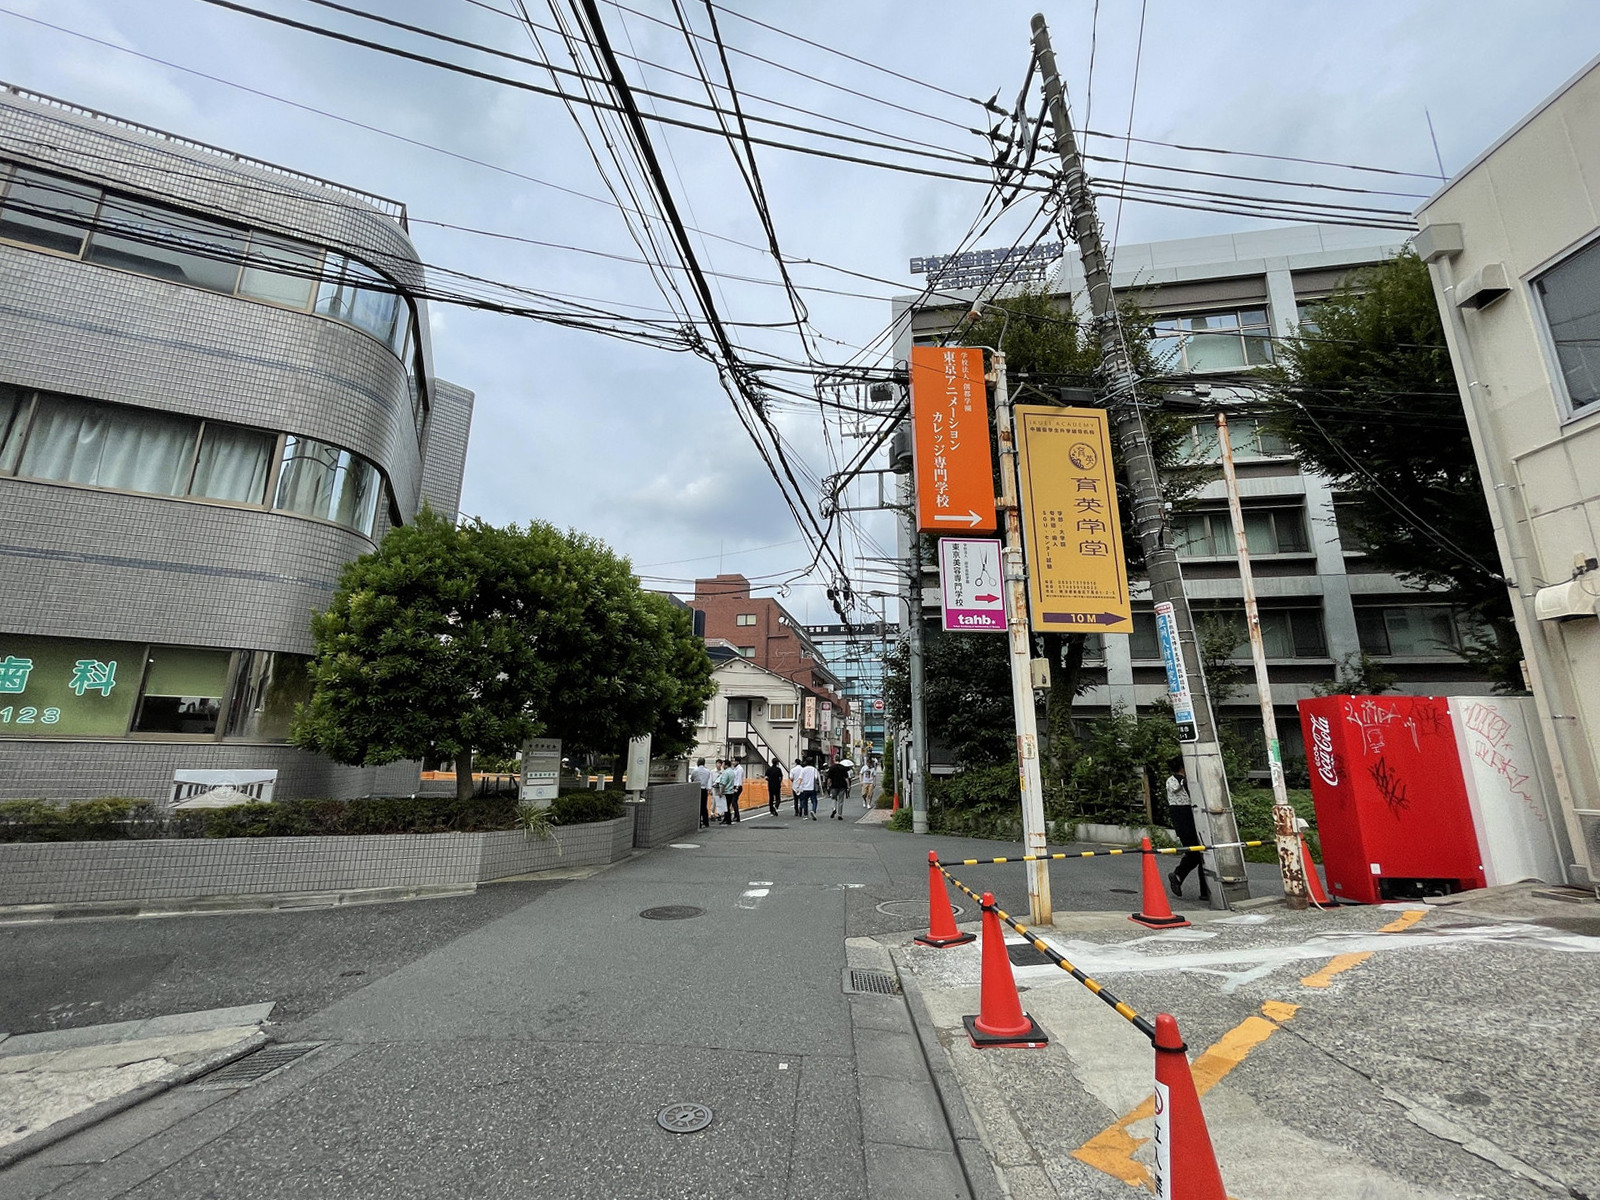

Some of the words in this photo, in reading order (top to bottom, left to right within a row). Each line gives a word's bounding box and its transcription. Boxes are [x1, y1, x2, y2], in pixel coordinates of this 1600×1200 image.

[944, 351, 960, 451] 東京アニメーション
[932, 411, 950, 508] カレッジ専門学校
[1070, 476, 1109, 556] 育英学堂
[952, 542, 964, 607] 東京美容専門学校
[1310, 712, 1338, 786] Coca-Cola
